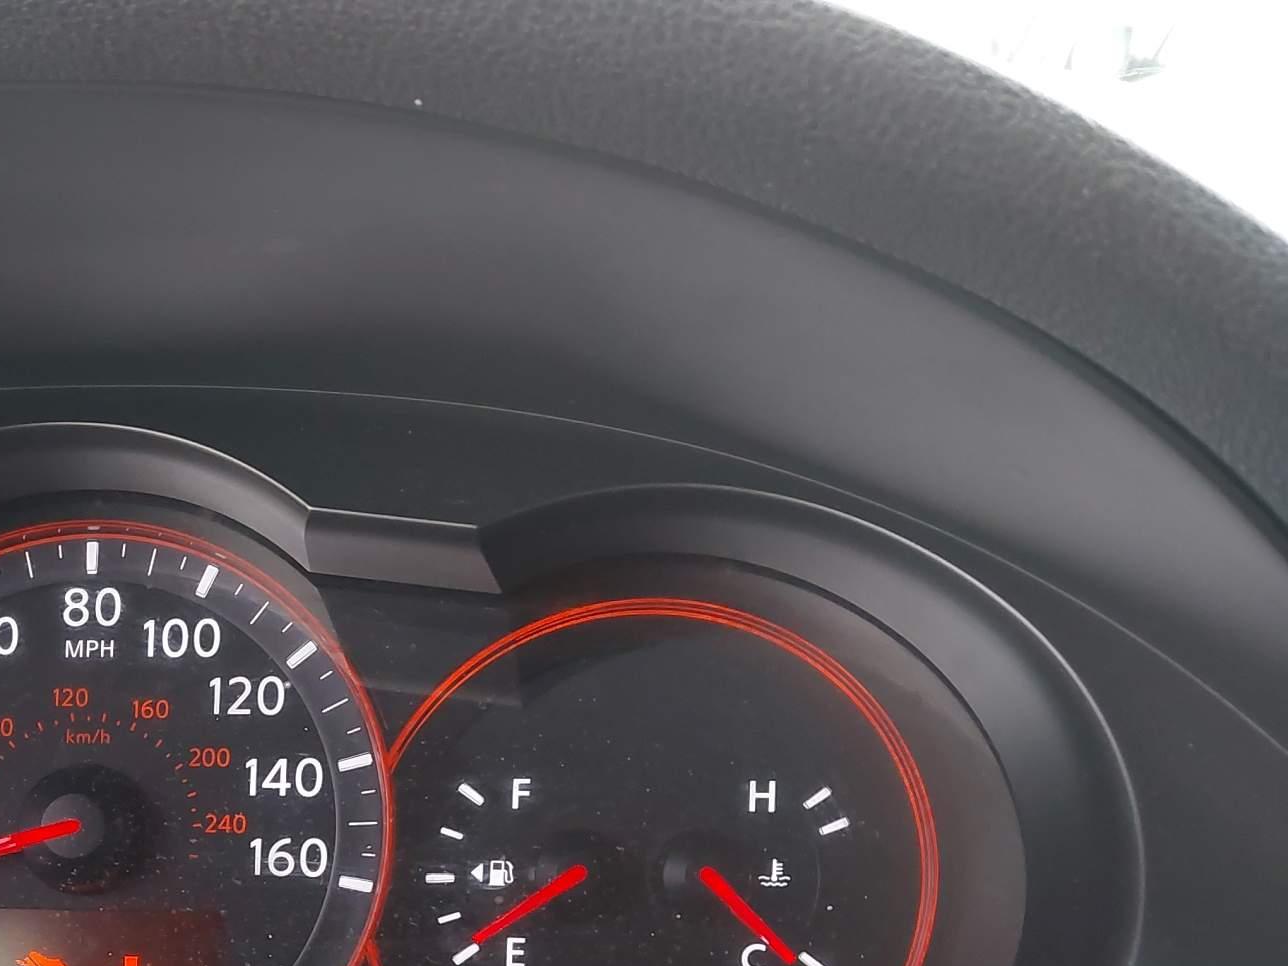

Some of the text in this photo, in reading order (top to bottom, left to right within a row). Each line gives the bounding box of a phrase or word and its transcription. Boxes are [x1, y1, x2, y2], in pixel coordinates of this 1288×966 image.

[63, 588, 121, 627] 80
[65, 640, 115, 658] MPH
[143, 617, 221, 658] 100
[53, 687, 89, 708] 120
[133, 699, 169, 719] 160
[210, 676, 284, 716] 120
[65, 728, 111, 744] km/h
[189, 748, 231, 768] 200
[245, 757, 323, 798] 140
[511, 778, 531, 809] F
[748, 780, 776, 813] H
[205, 813, 247, 834] 240
[250, 837, 328, 878] 160
